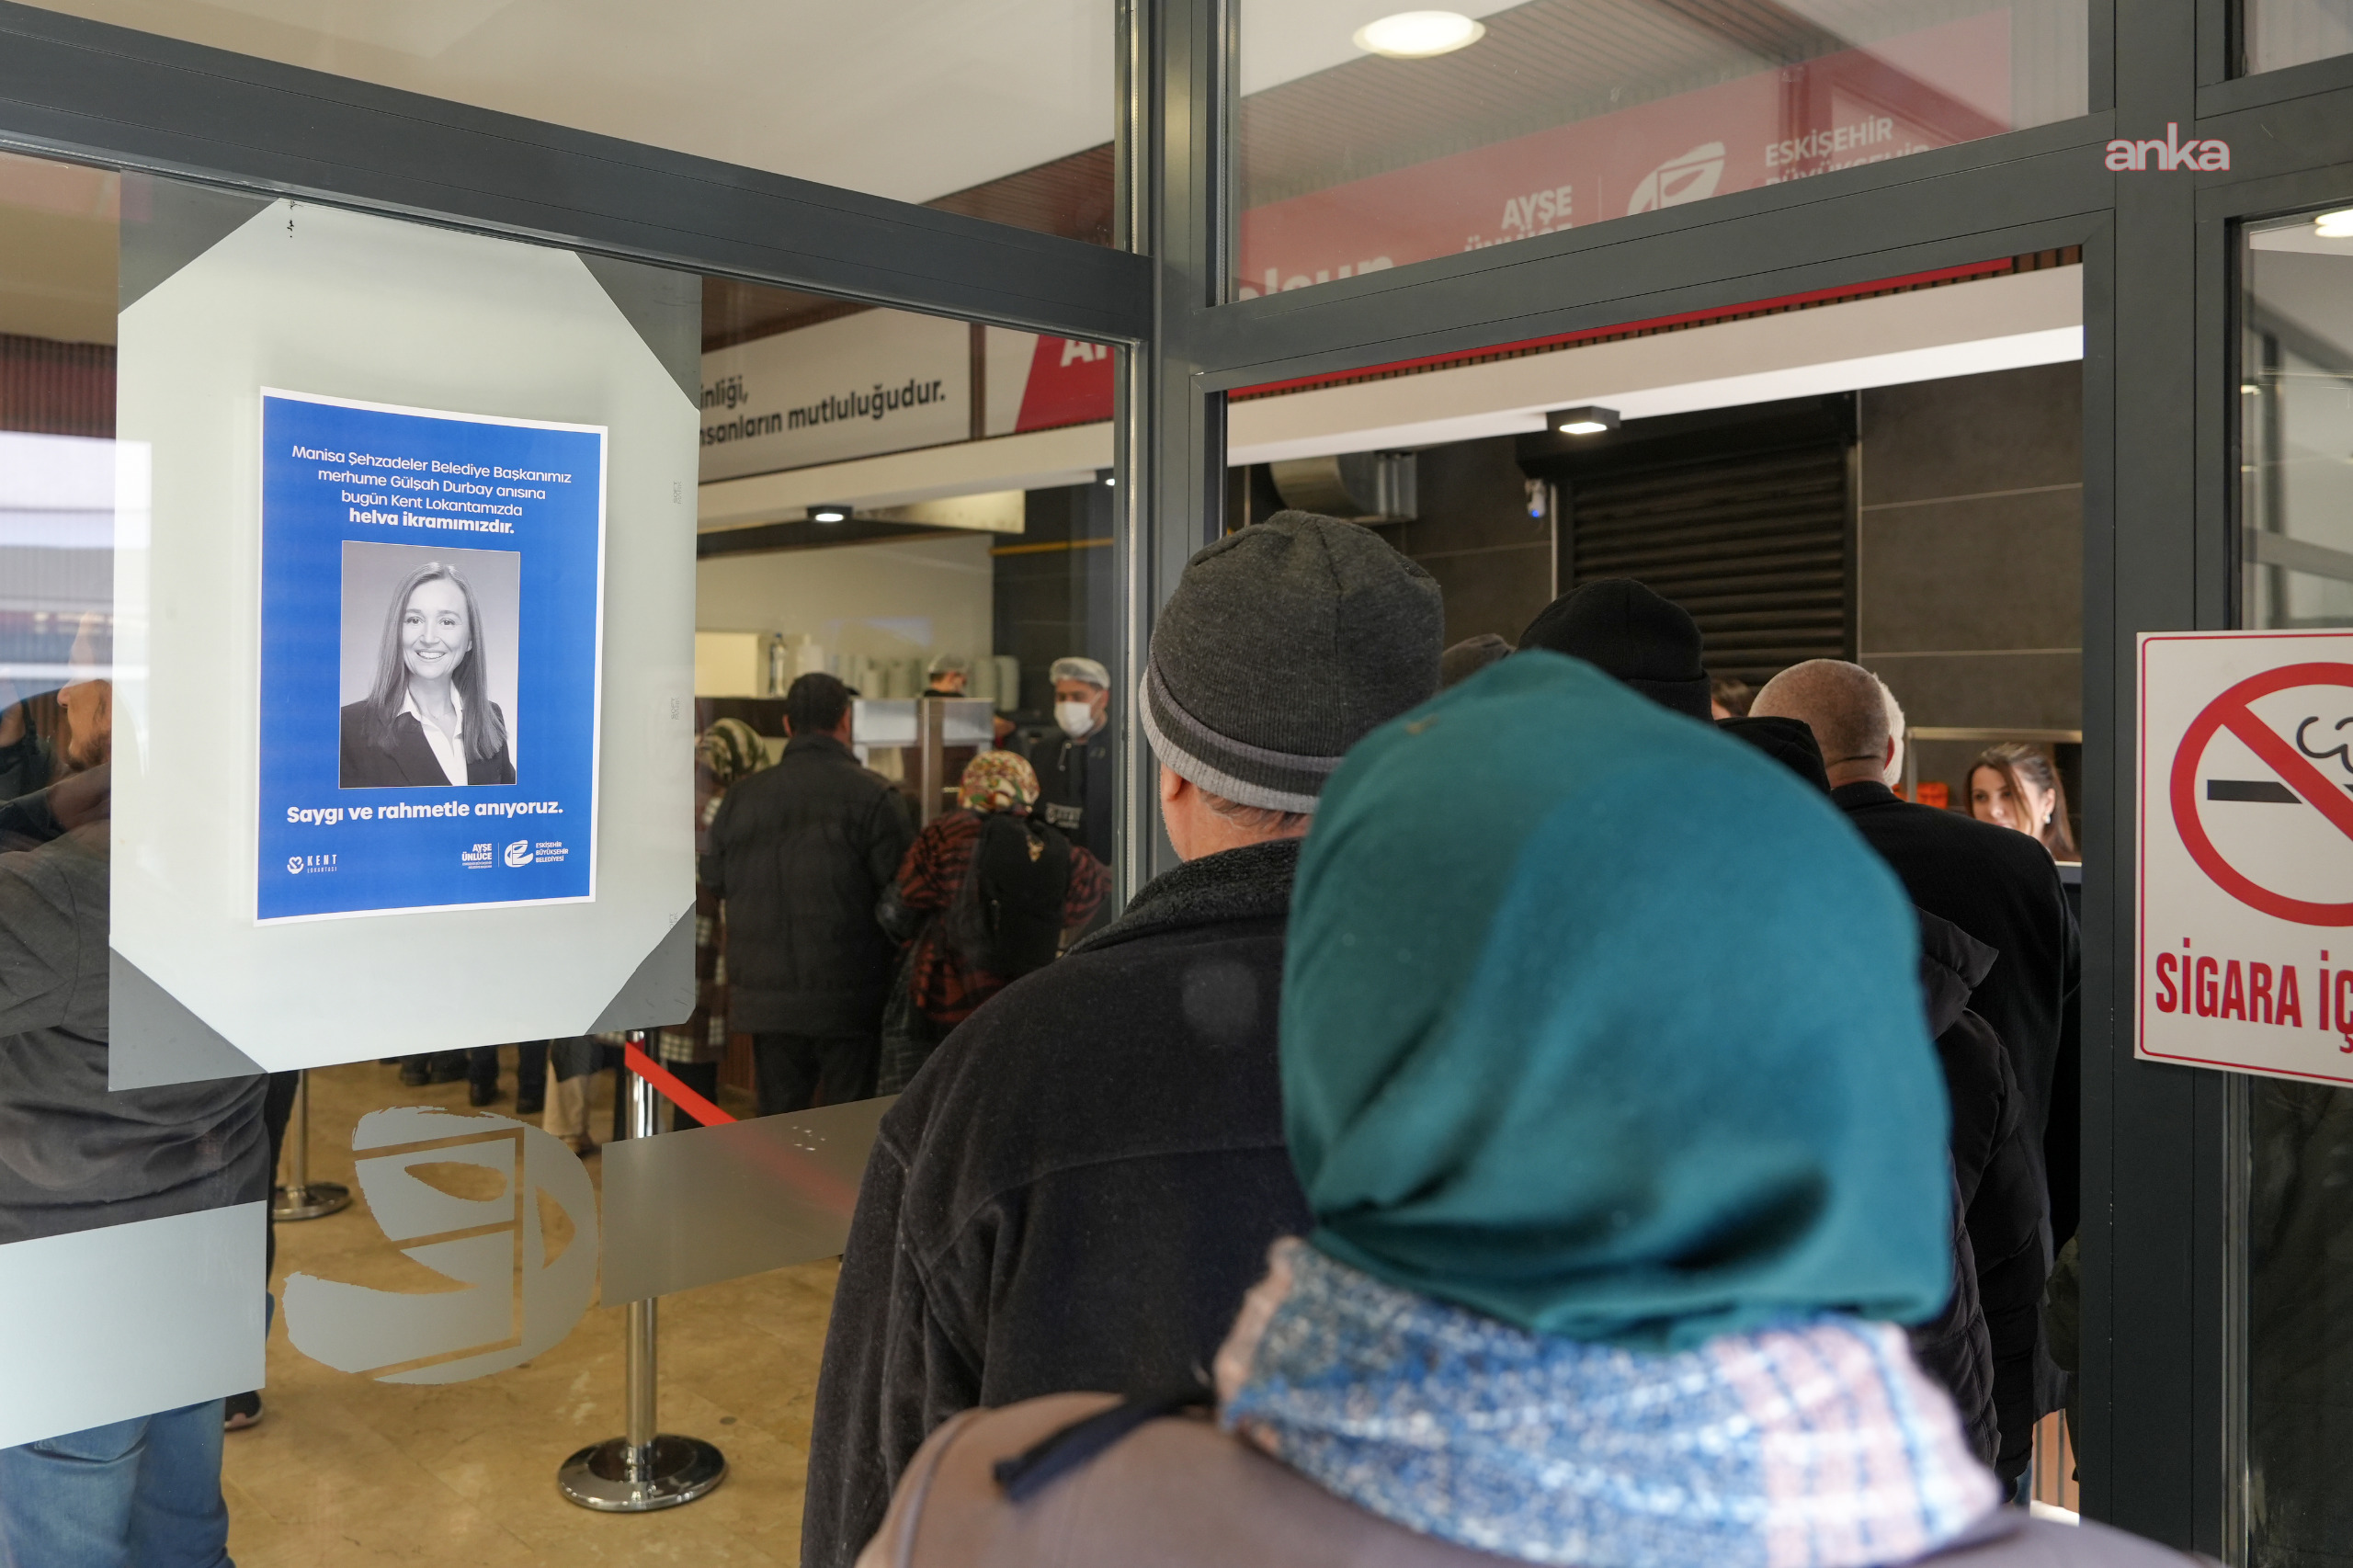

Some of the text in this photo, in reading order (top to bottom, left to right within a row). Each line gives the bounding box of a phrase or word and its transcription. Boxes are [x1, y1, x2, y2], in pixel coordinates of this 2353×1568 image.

[1765, 115, 1893, 167] ESKİŞEHİR
[1501, 185, 1573, 232] AYŞE
[789, 378, 946, 430] mutluluğudur.
[291, 445, 572, 483] Manisa Şehzadeler Belediye Başkanımız
[318, 470, 546, 500] merhume Gülşah Durbay anısına
[341, 489, 523, 517] bugün Kent Lokantamızda
[349, 507, 515, 534] helva ikramımızdır.
[287, 801, 563, 825] Saygı ve rahmetle anıyoruz.
[307, 854, 337, 867] KENT
[461, 851, 493, 862] ÜNLÜCE
[472, 843, 493, 852] AYŞE
[2155, 937, 2302, 1028] SİGARA
